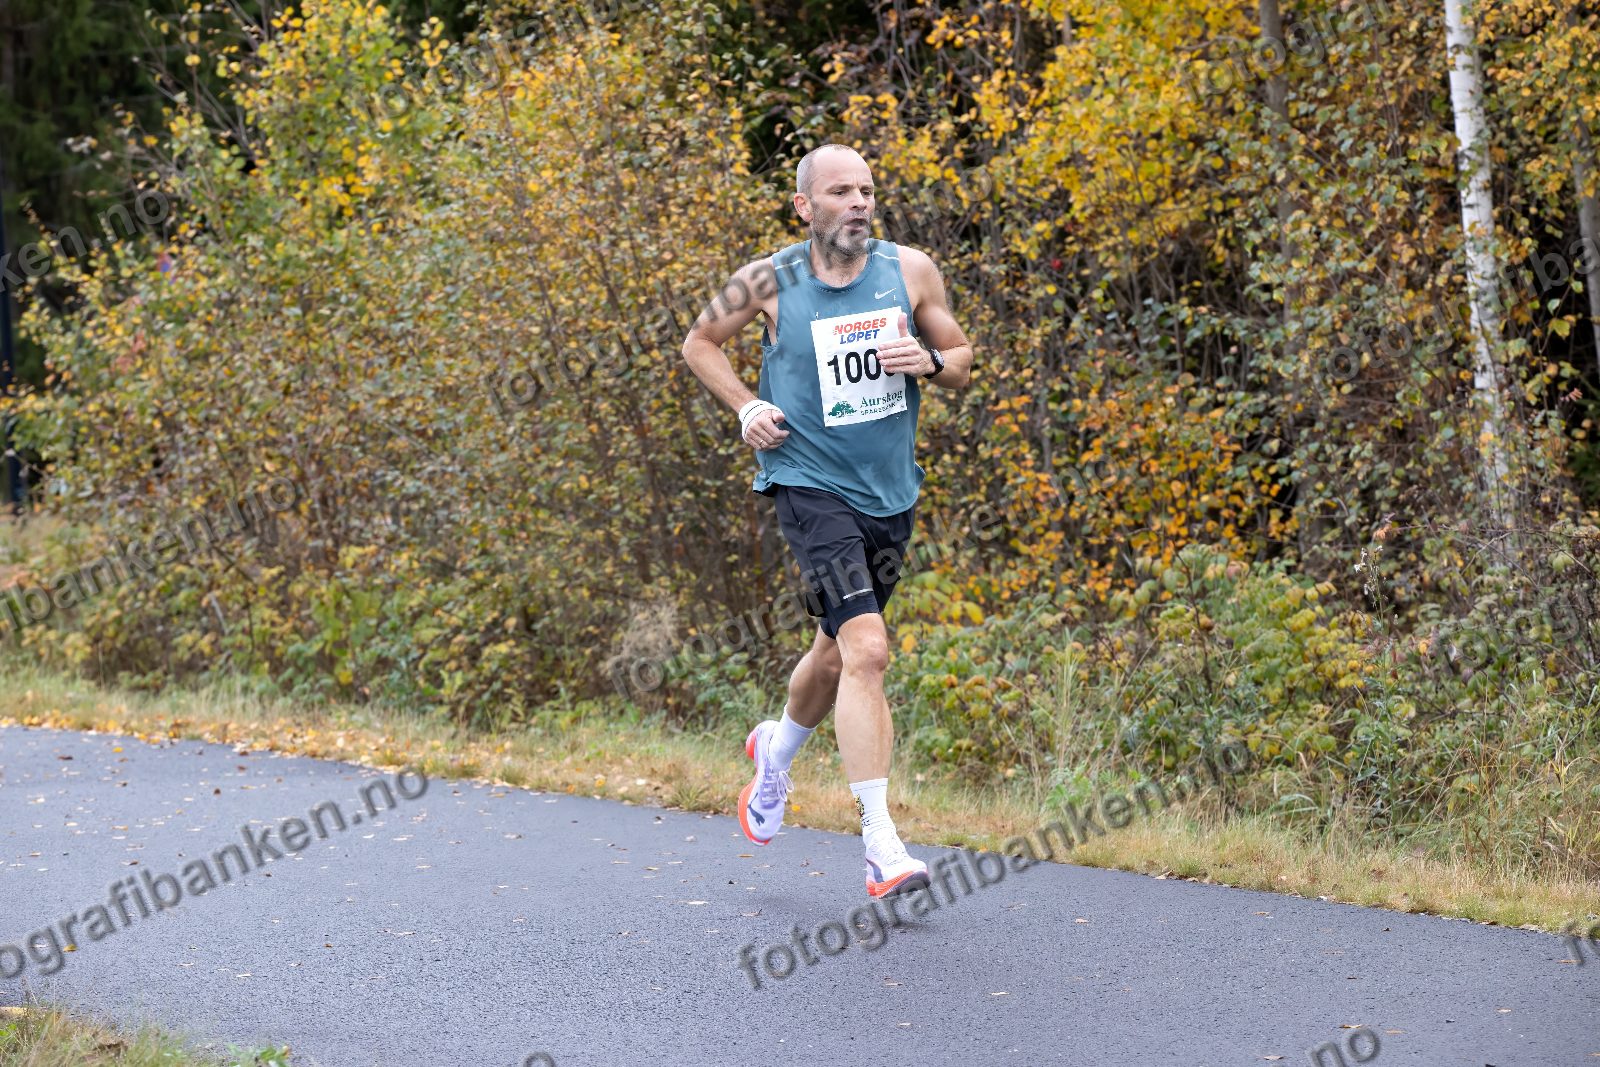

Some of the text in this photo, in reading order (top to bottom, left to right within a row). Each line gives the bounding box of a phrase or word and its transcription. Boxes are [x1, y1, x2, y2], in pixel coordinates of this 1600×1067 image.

[834, 318, 887, 335] NORGES
[839, 329, 880, 344] LØPET
[827, 348, 895, 386] 100
[860, 391, 903, 408] Aurskog
